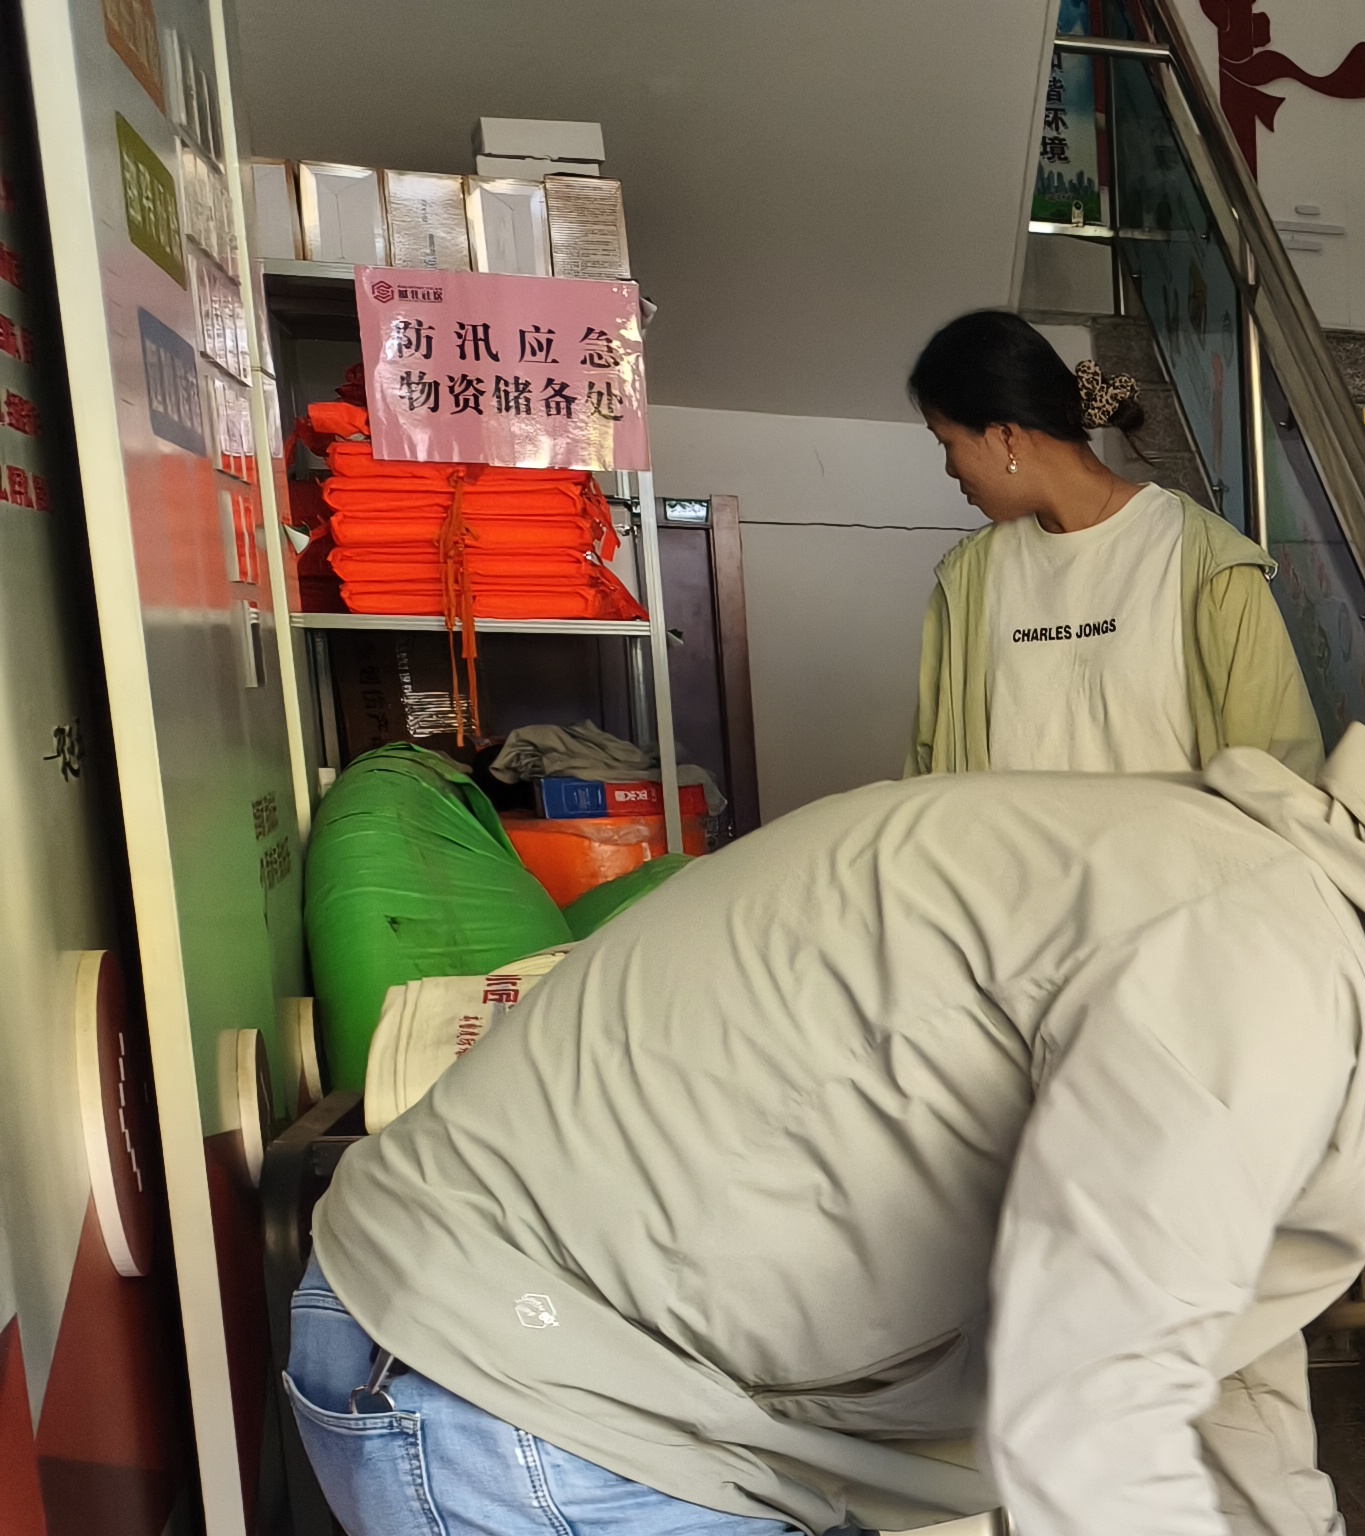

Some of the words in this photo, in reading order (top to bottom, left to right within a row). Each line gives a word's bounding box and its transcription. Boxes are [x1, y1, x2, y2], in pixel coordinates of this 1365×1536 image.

[395, 318, 621, 369] 防汛应急
[398, 370, 624, 422] 物资储备处
[1012, 624, 1072, 643] CHARLES
[1075, 618, 1117, 639] JONGS
